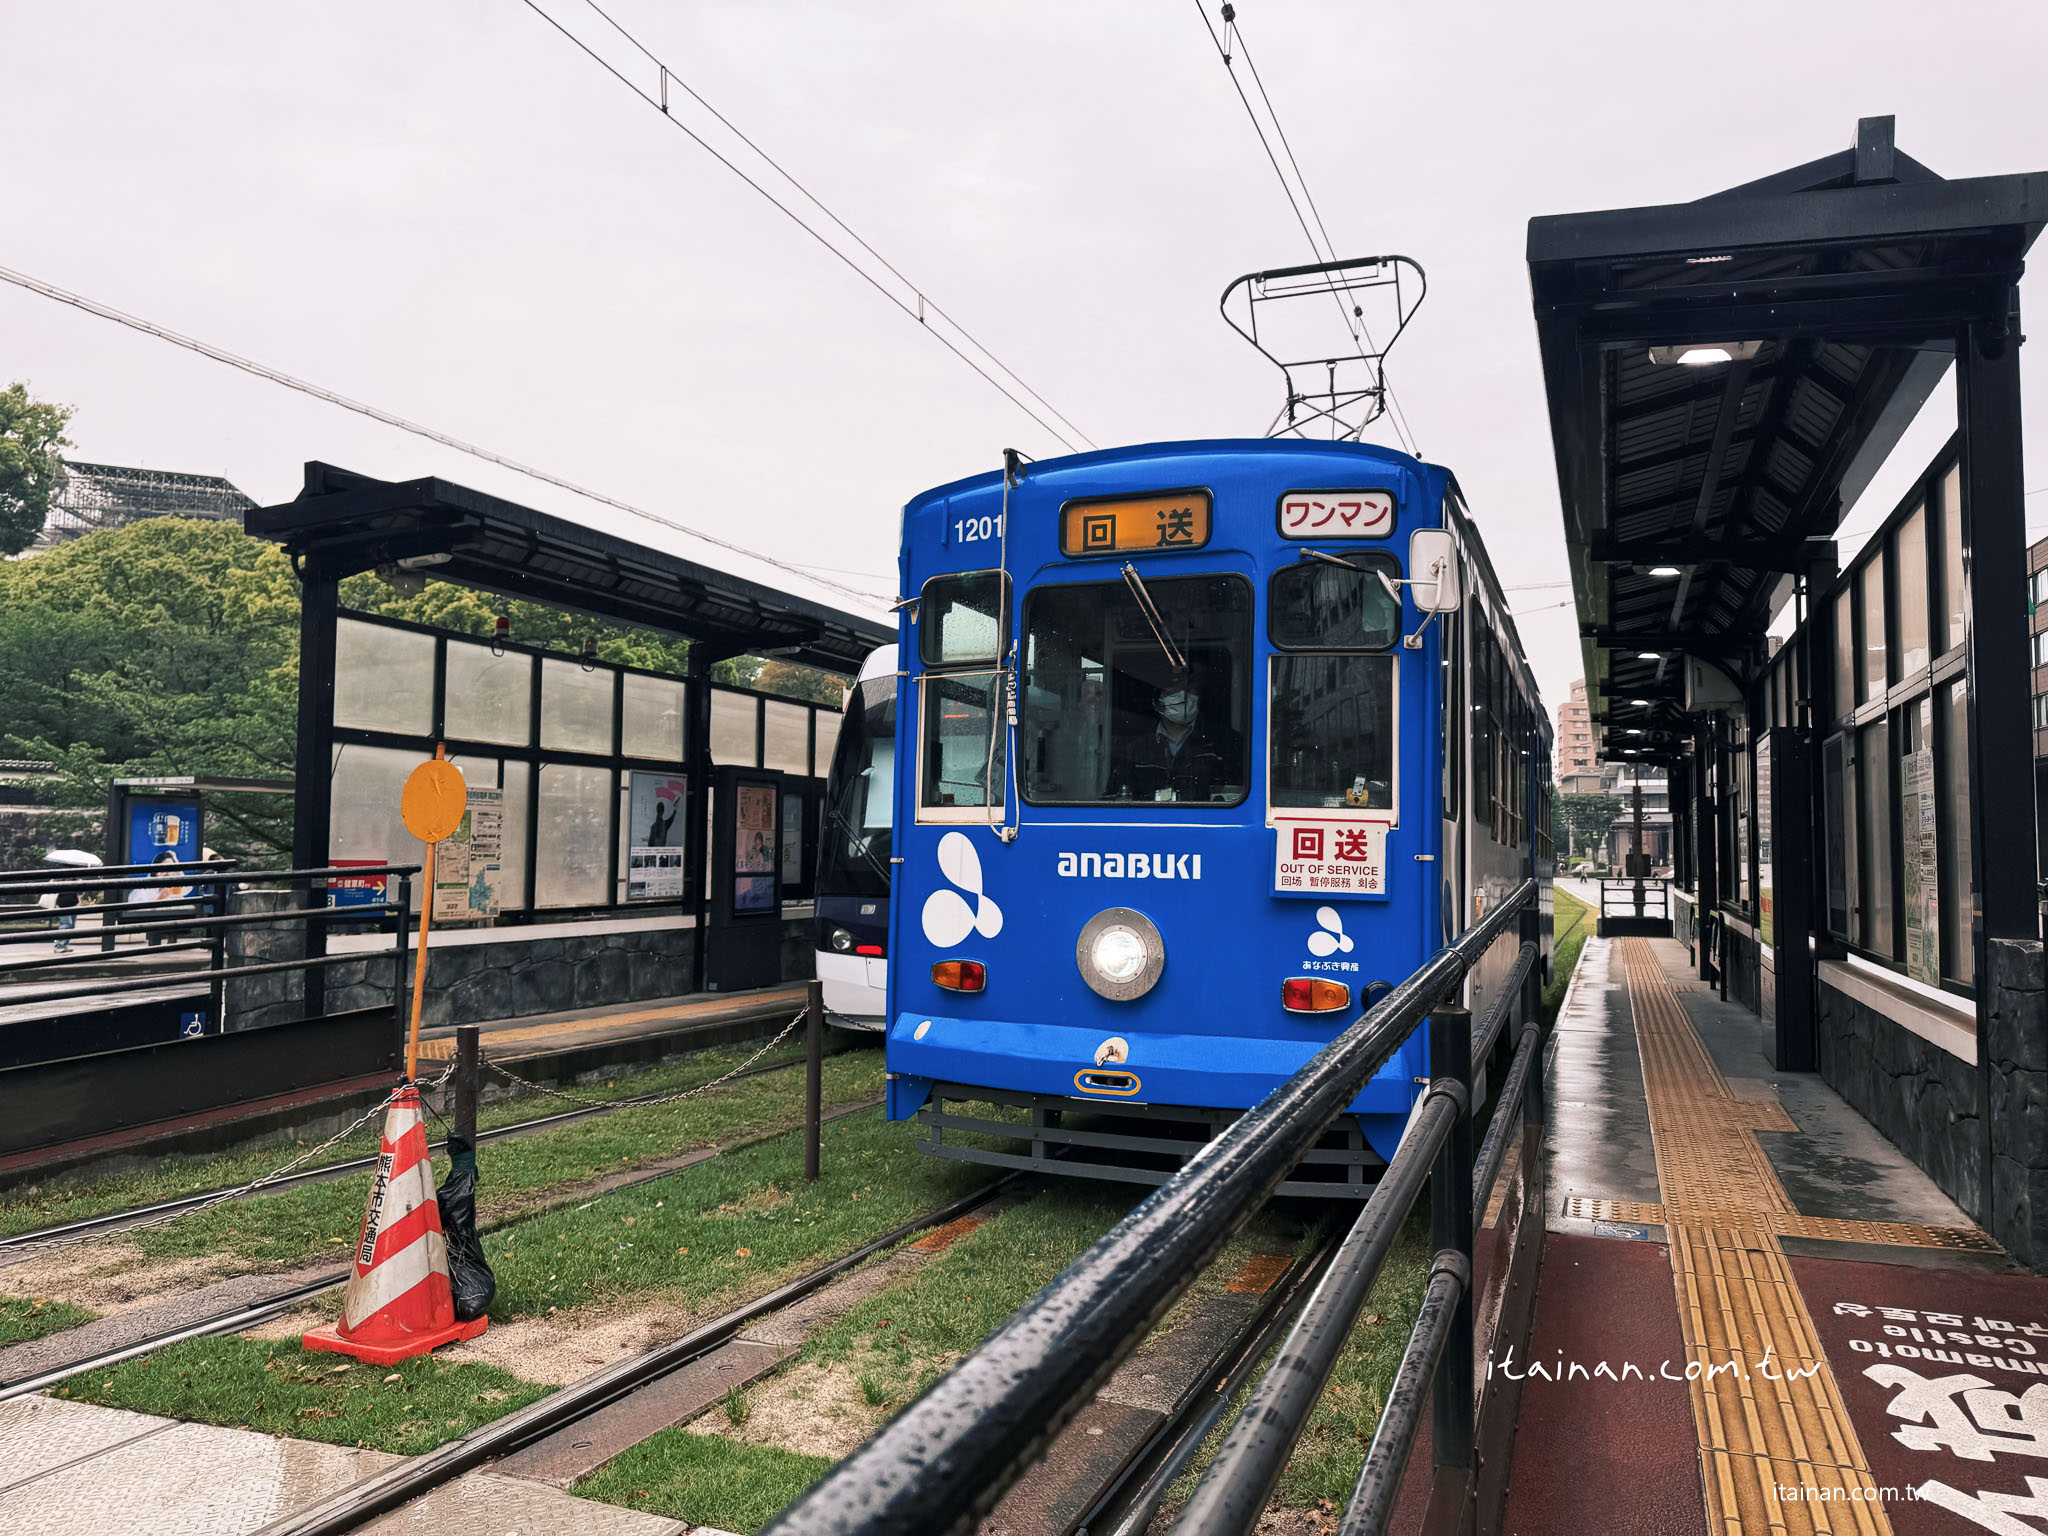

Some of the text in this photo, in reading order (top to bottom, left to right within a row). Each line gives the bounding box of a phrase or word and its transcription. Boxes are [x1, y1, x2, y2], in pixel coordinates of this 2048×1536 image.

[954, 514, 1004, 544] 1201
[1082, 507, 1194, 553] 回送
[1286, 501, 1389, 528] ワンマン
[1292, 828, 1368, 862] 回送
[1280, 863, 1379, 876] OUT OF SERVICE
[359, 1155, 393, 1263] 熊本市交通局
[1883, 1324, 2037, 1355] Castle
[1849, 1339, 2048, 1376] mamoto
